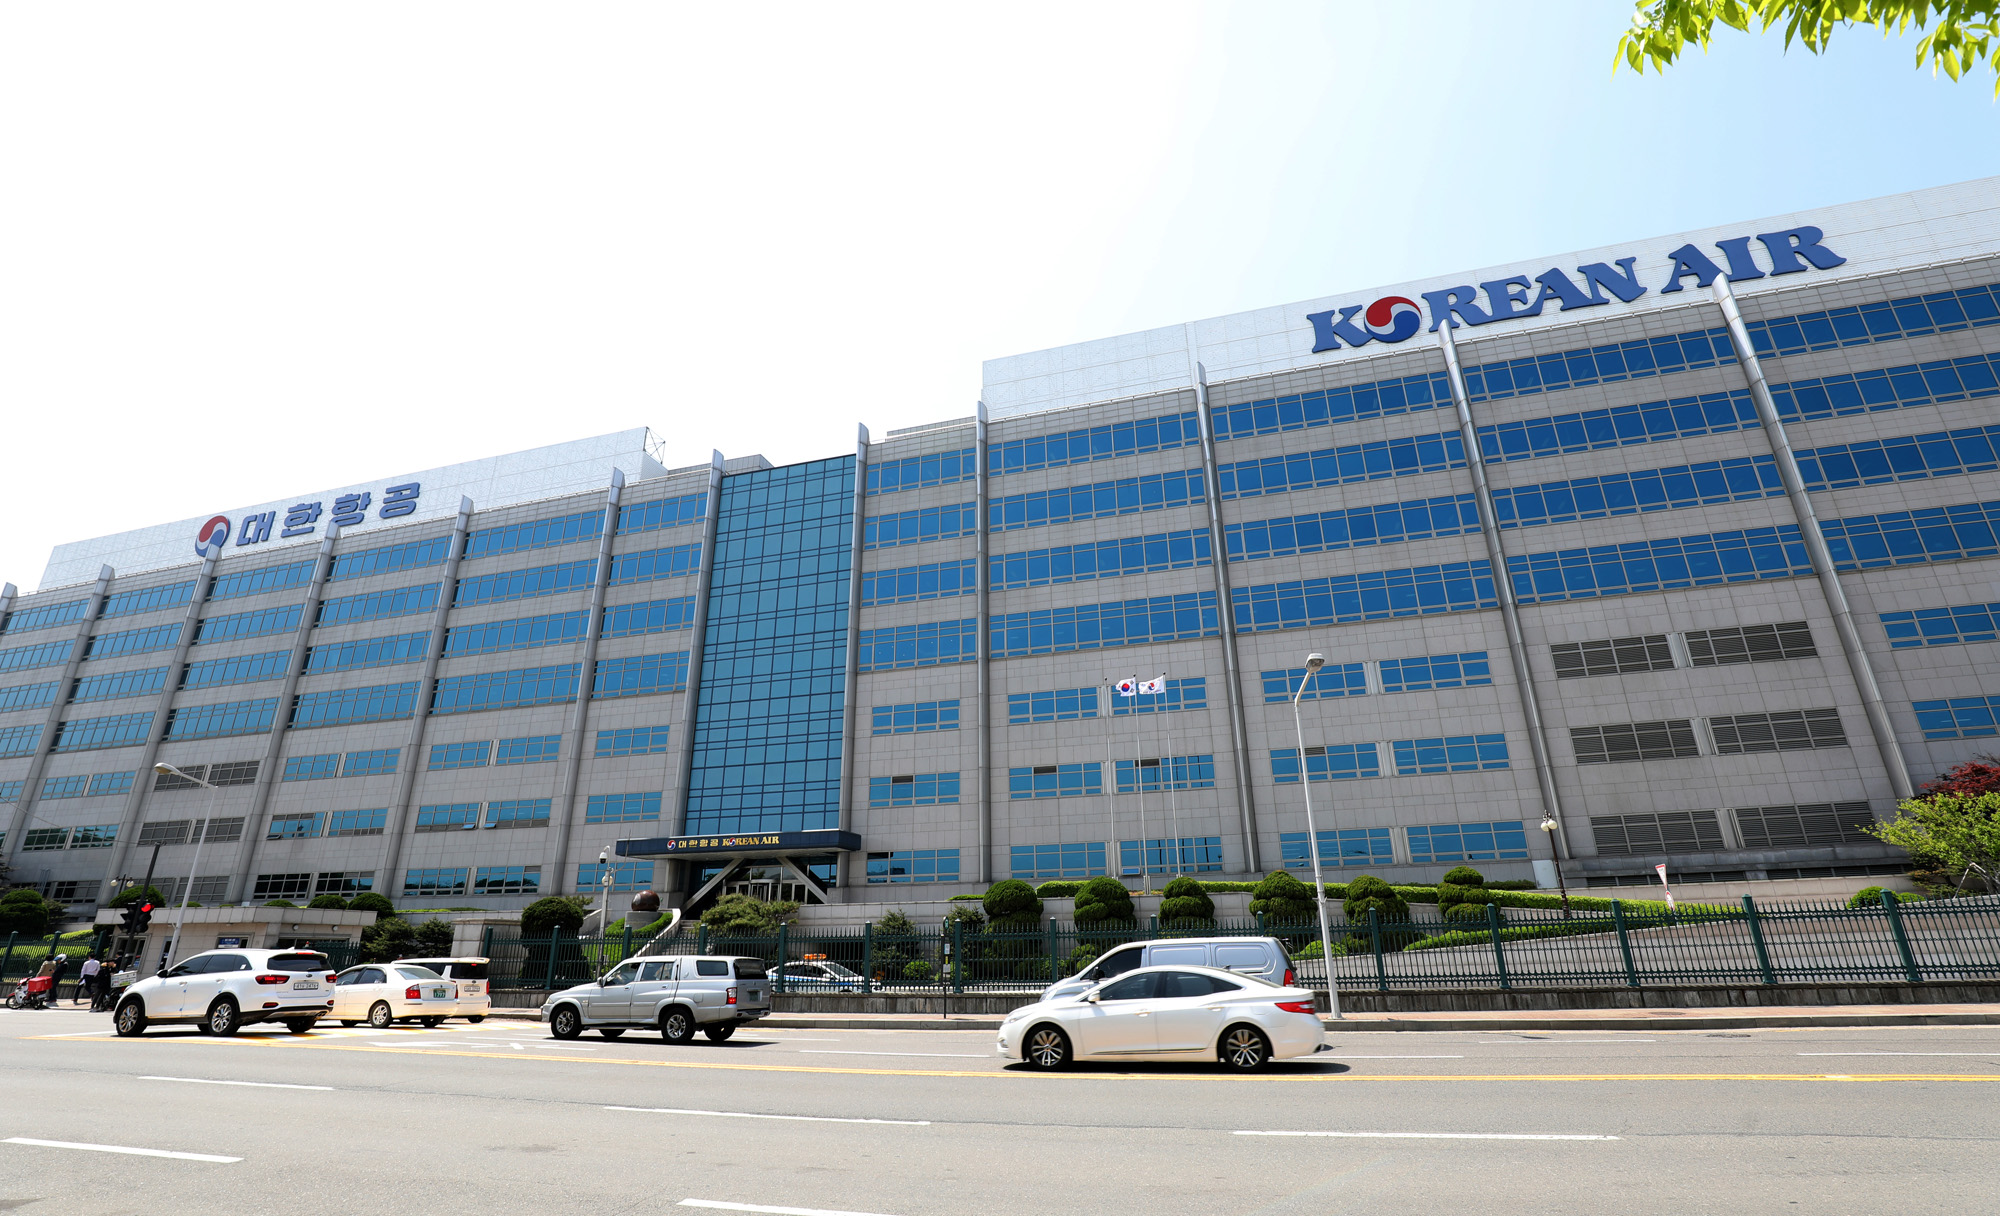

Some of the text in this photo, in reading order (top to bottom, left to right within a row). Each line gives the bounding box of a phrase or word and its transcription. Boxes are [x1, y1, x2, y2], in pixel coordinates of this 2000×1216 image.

[1306, 226, 1847, 353] KOREAN AIR
[236, 482, 420, 546] 대한항공
[678, 836, 780, 848] 대한항공 KOREAN AIR
